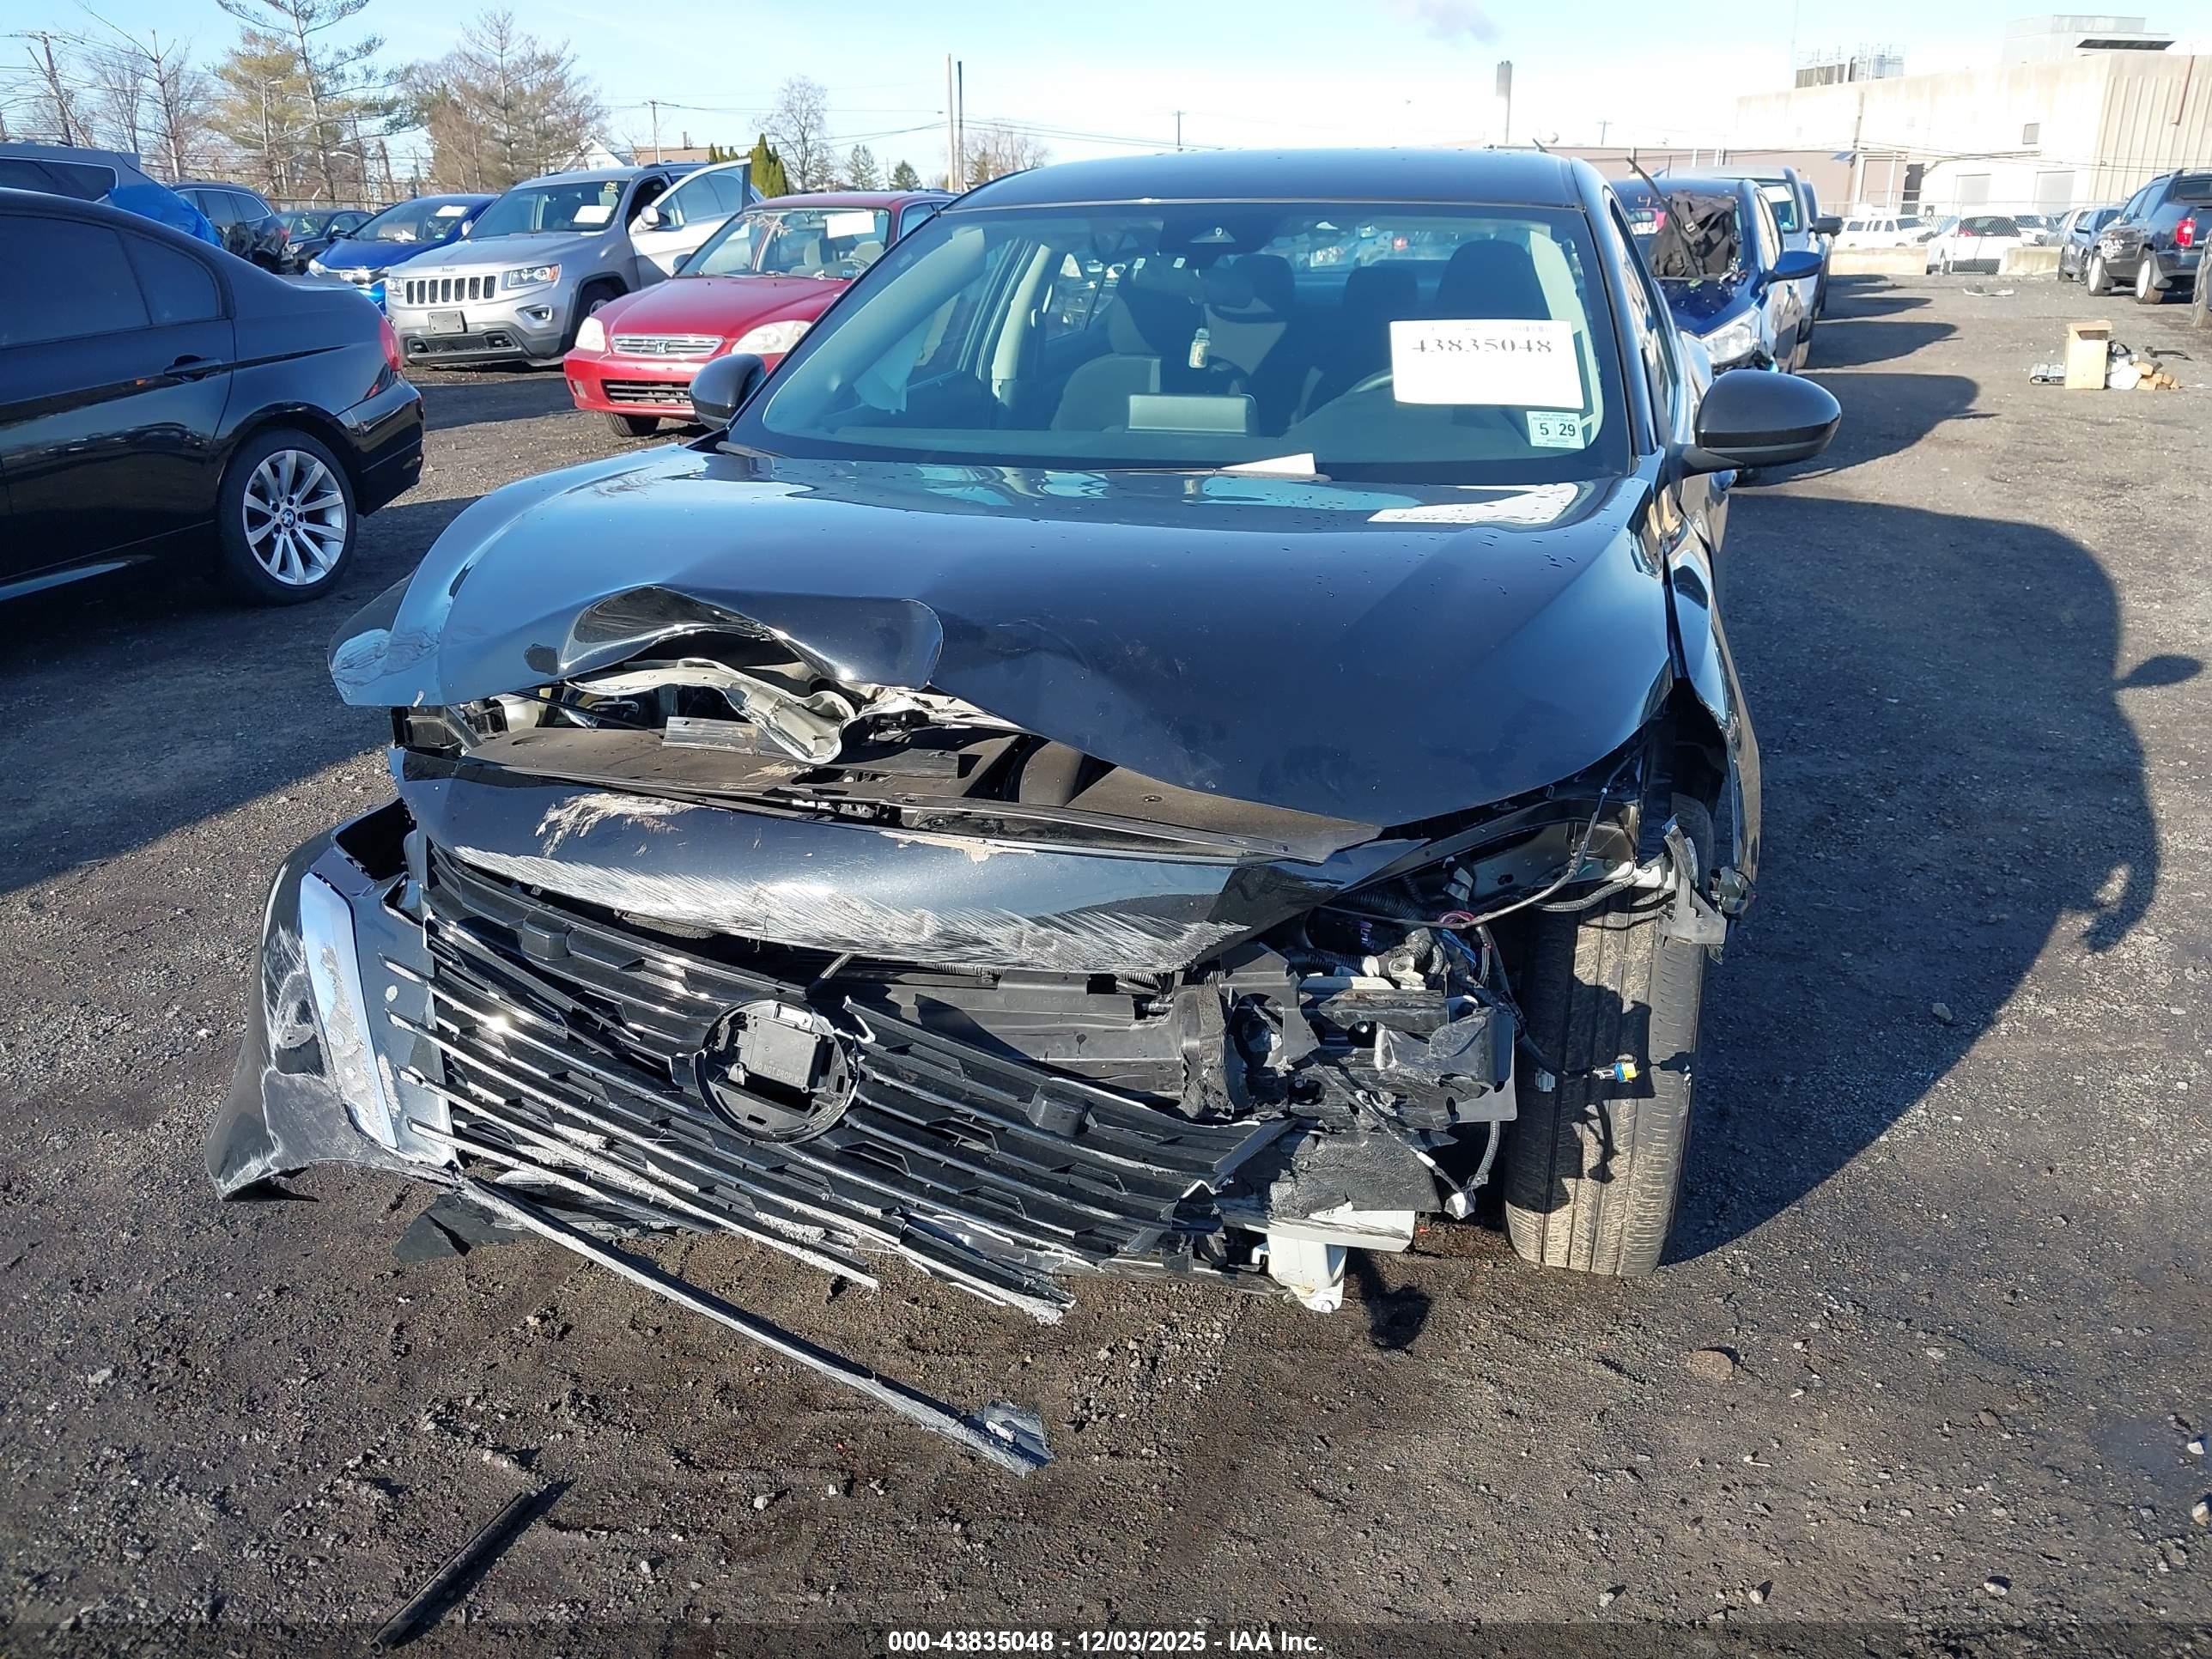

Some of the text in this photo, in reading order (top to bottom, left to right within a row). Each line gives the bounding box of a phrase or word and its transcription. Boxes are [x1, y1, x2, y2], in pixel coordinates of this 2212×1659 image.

[1412, 338, 1552, 353] 43835048
[1539, 422, 1577, 437] 5 29
